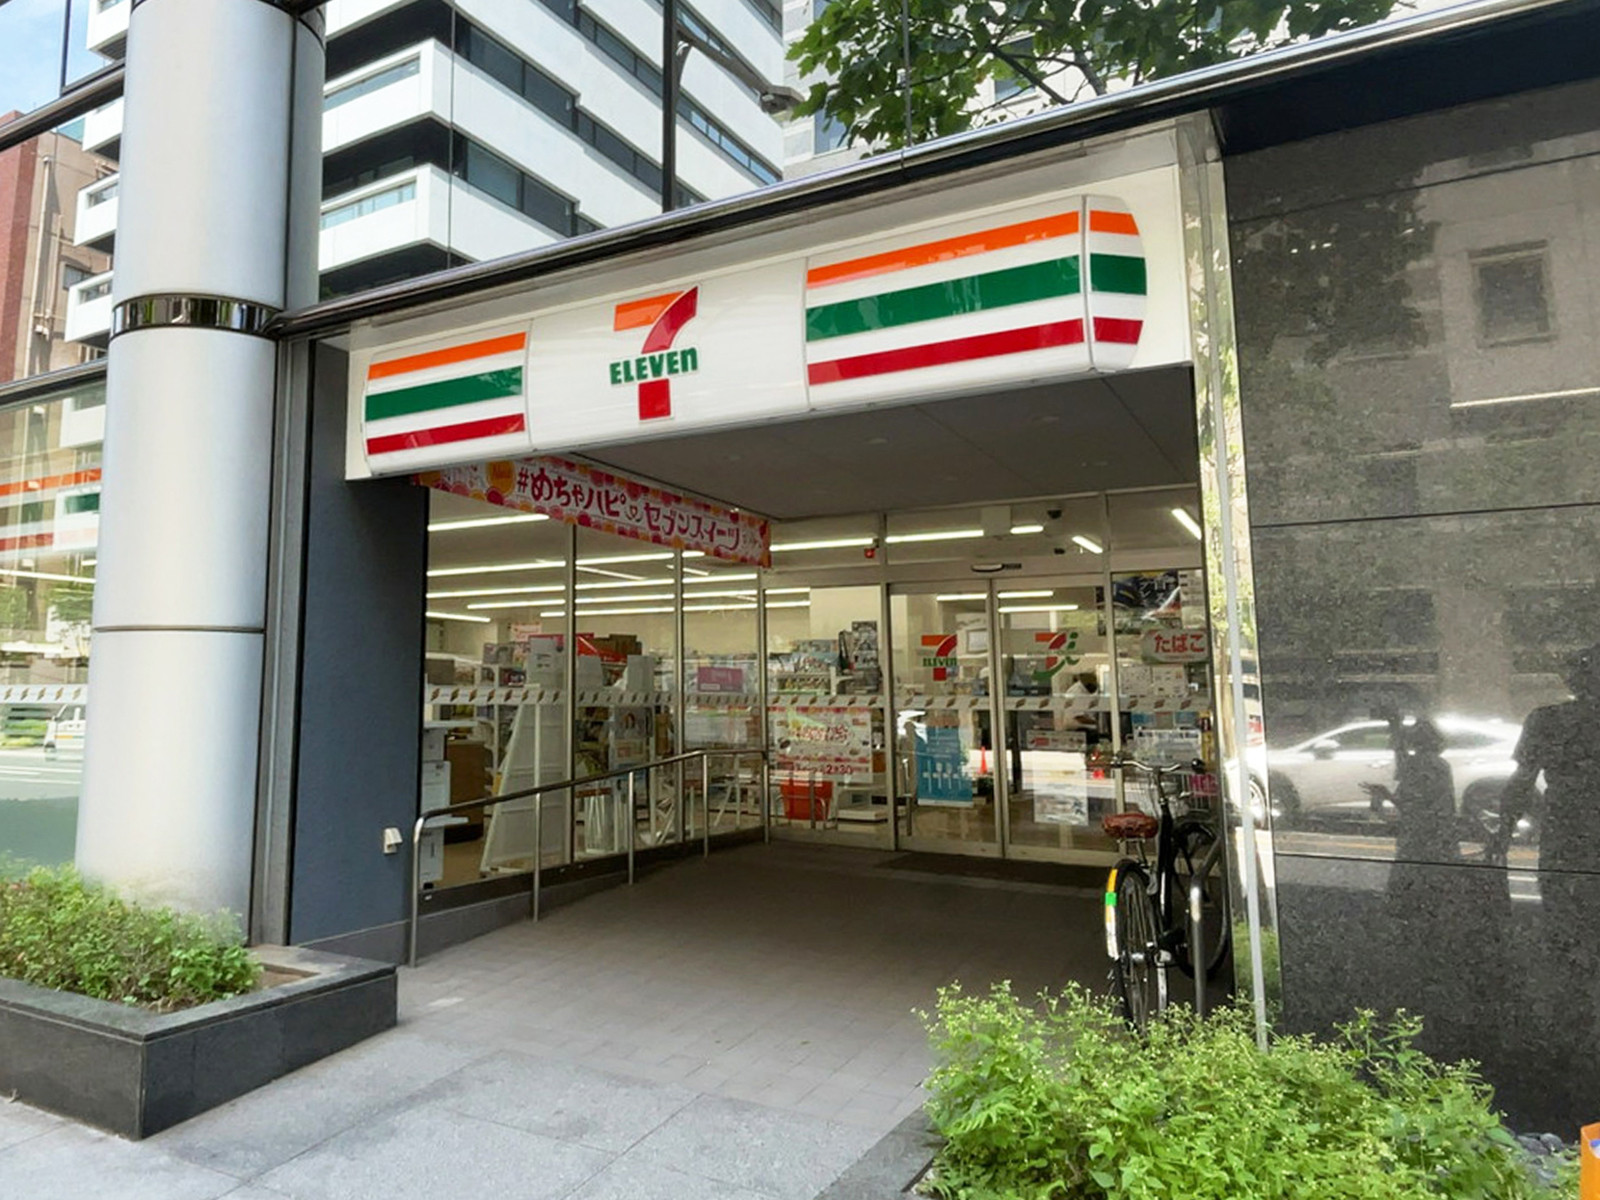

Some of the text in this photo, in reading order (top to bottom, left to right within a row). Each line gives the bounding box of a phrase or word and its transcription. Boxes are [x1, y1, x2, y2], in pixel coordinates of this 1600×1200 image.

[613, 285, 699, 421] 7
[1154, 633, 1205, 653] たばこ
